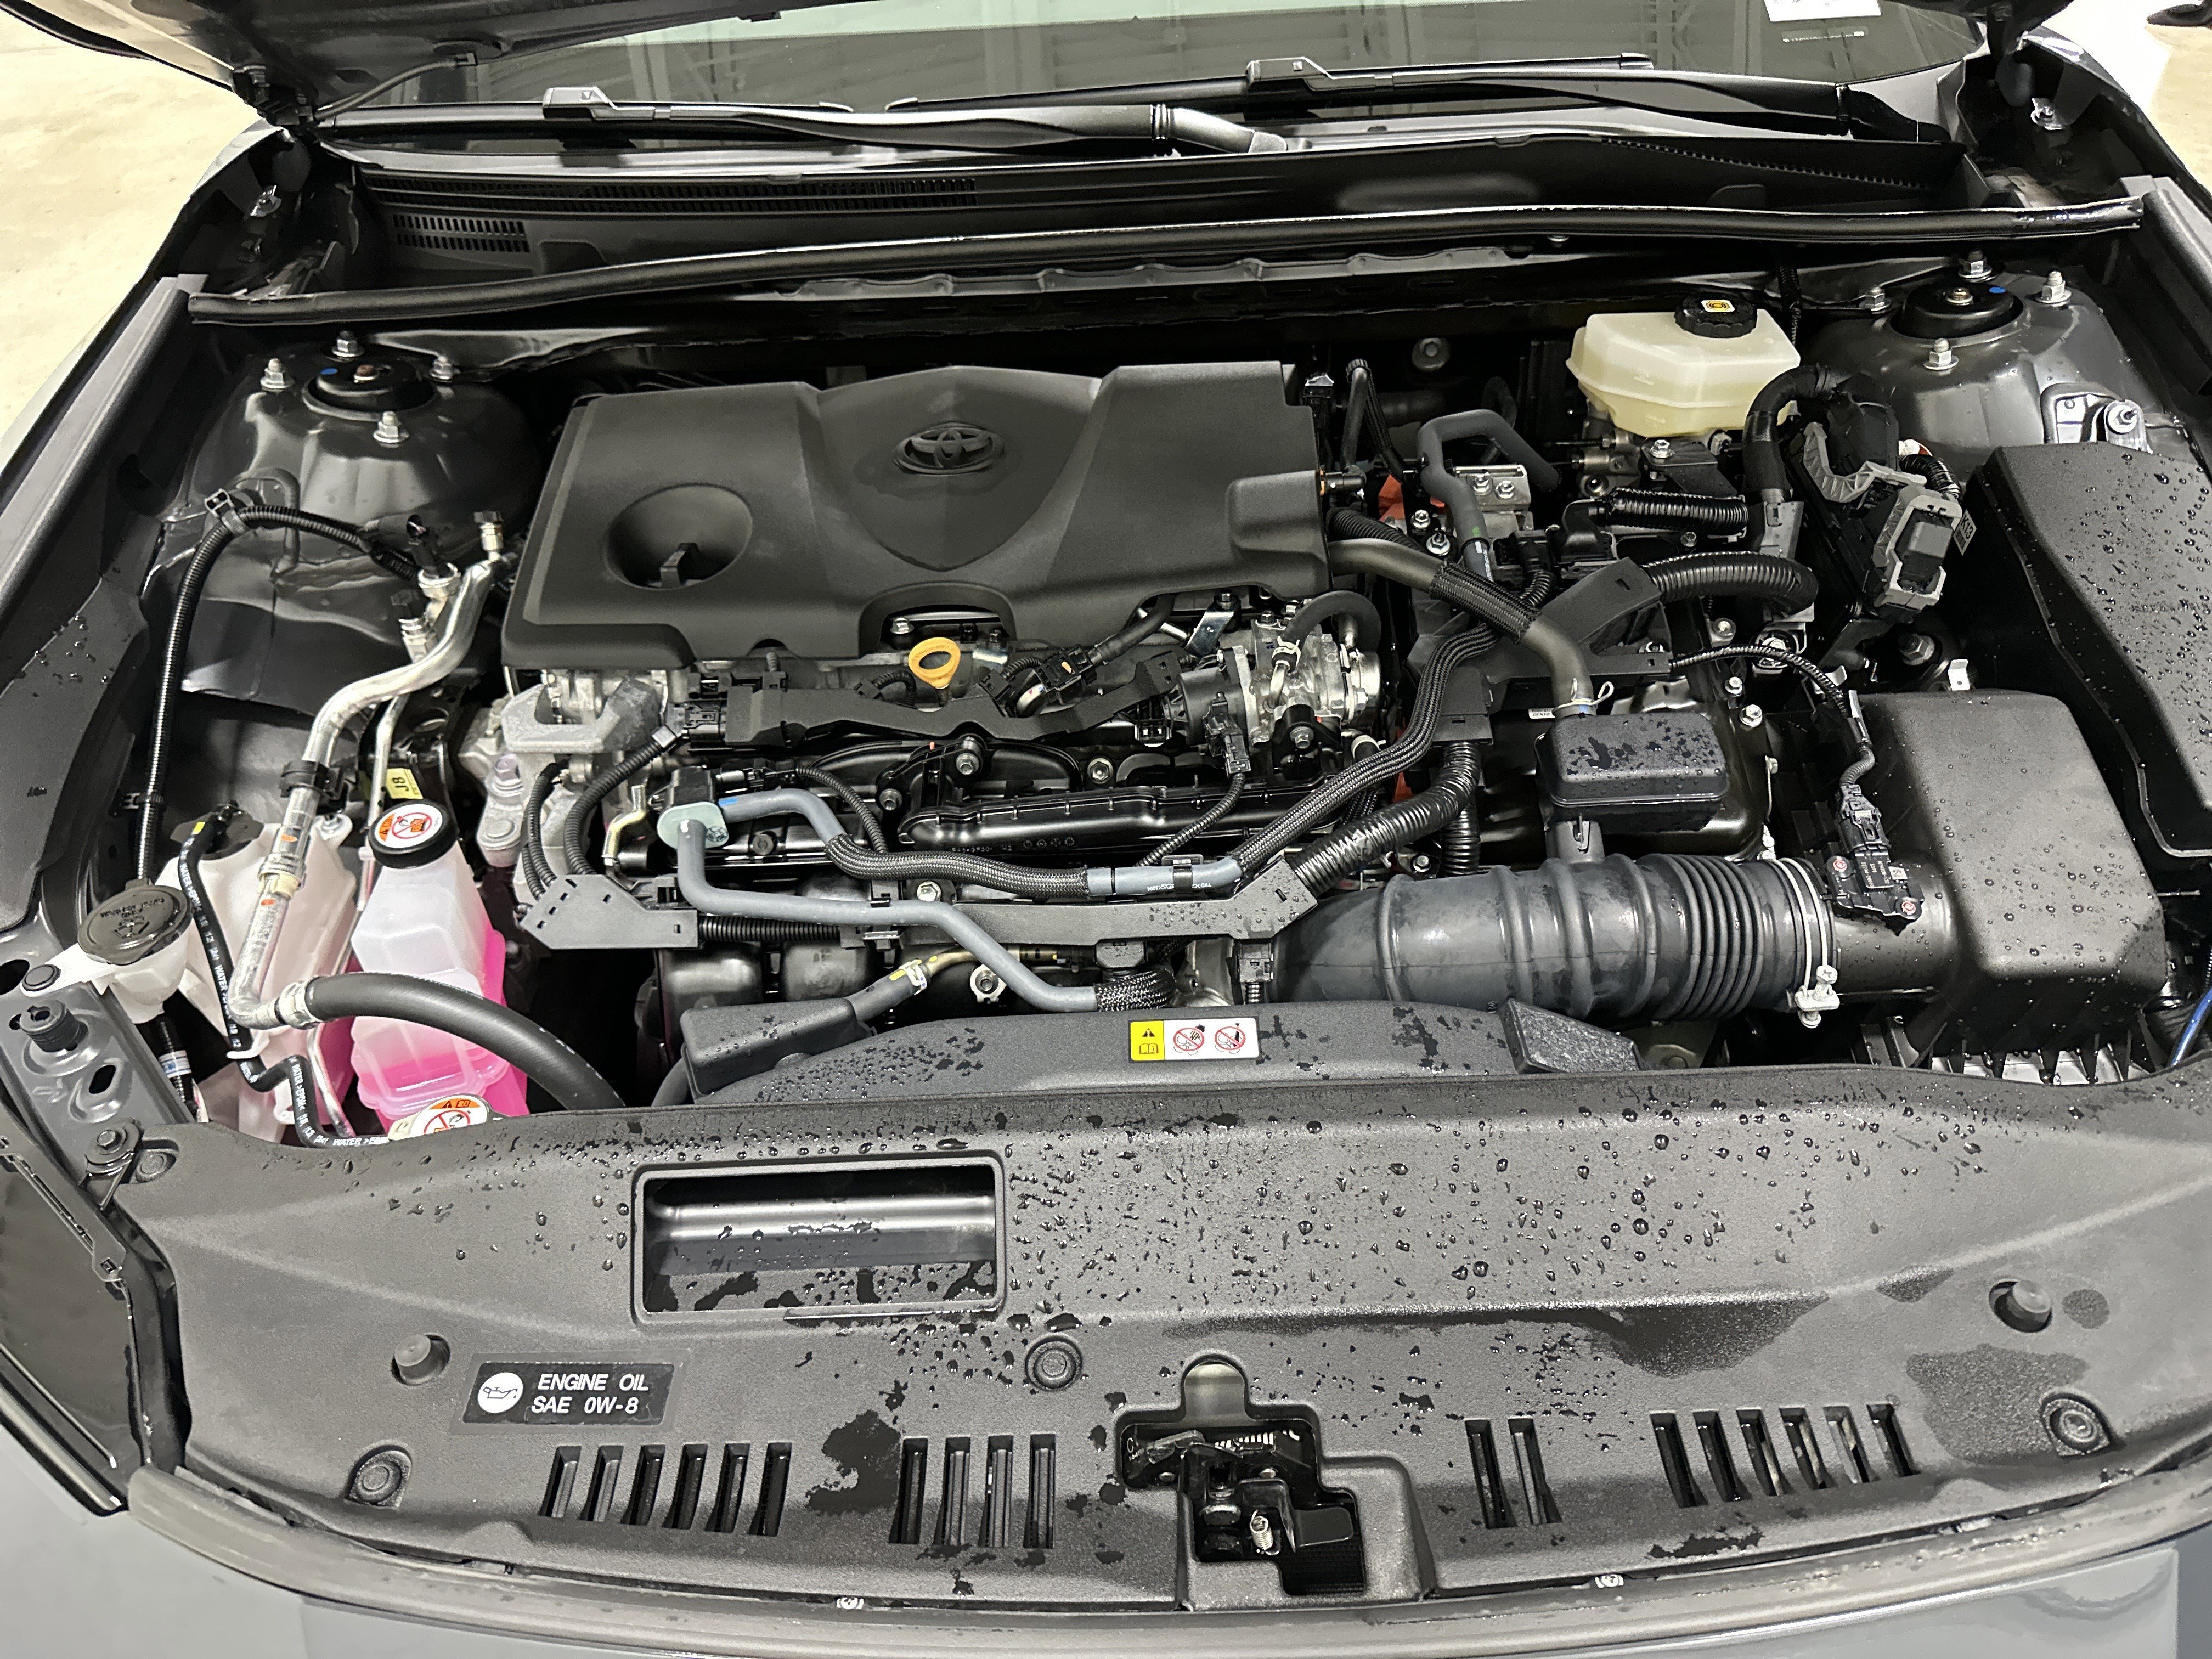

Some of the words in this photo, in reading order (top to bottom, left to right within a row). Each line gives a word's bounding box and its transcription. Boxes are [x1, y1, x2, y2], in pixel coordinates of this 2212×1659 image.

[1961, 515, 1973, 539] K13
[392, 777, 410, 791] J8
[180, 863, 193, 887] WATER
[215, 964, 228, 991] WATER
[292, 1063, 303, 1086] WATER
[332, 1137, 362, 1147] WATER
[537, 1373, 608, 1391] ENGINE
[619, 1374, 649, 1391] OIL
[531, 1396, 572, 1414] SAE
[584, 1396, 639, 1414] 0W-8
